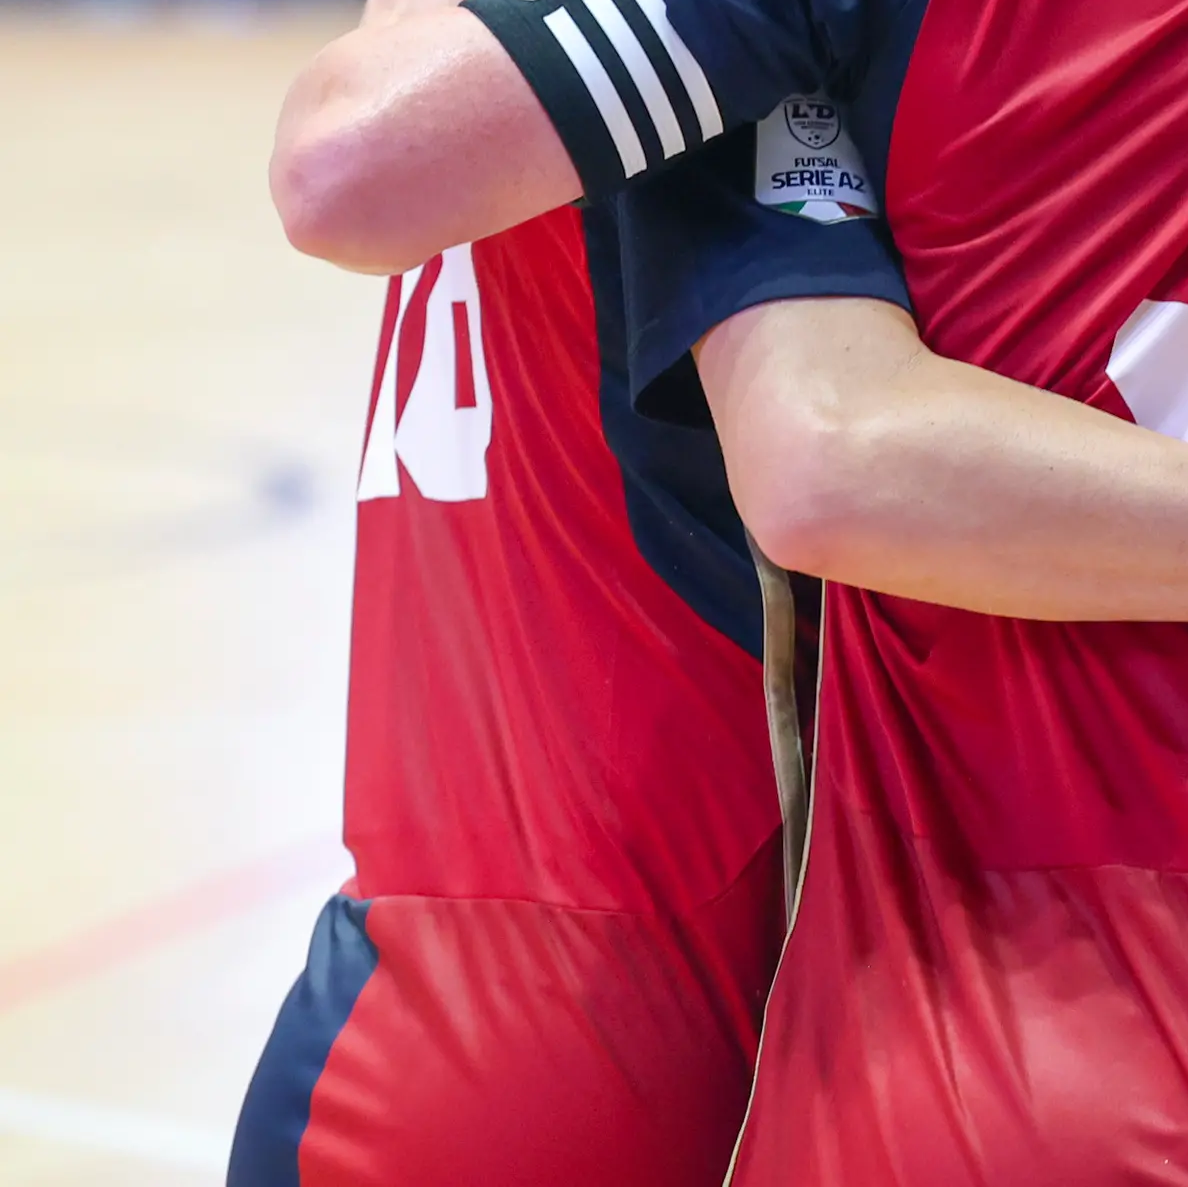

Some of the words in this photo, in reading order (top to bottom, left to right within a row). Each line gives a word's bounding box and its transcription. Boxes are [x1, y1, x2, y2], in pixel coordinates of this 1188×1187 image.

[794, 156, 842, 169] FUTSAL
[771, 169, 835, 190] SERIE
[838, 171, 868, 195] A2
[806, 188, 835, 197] ELITE
